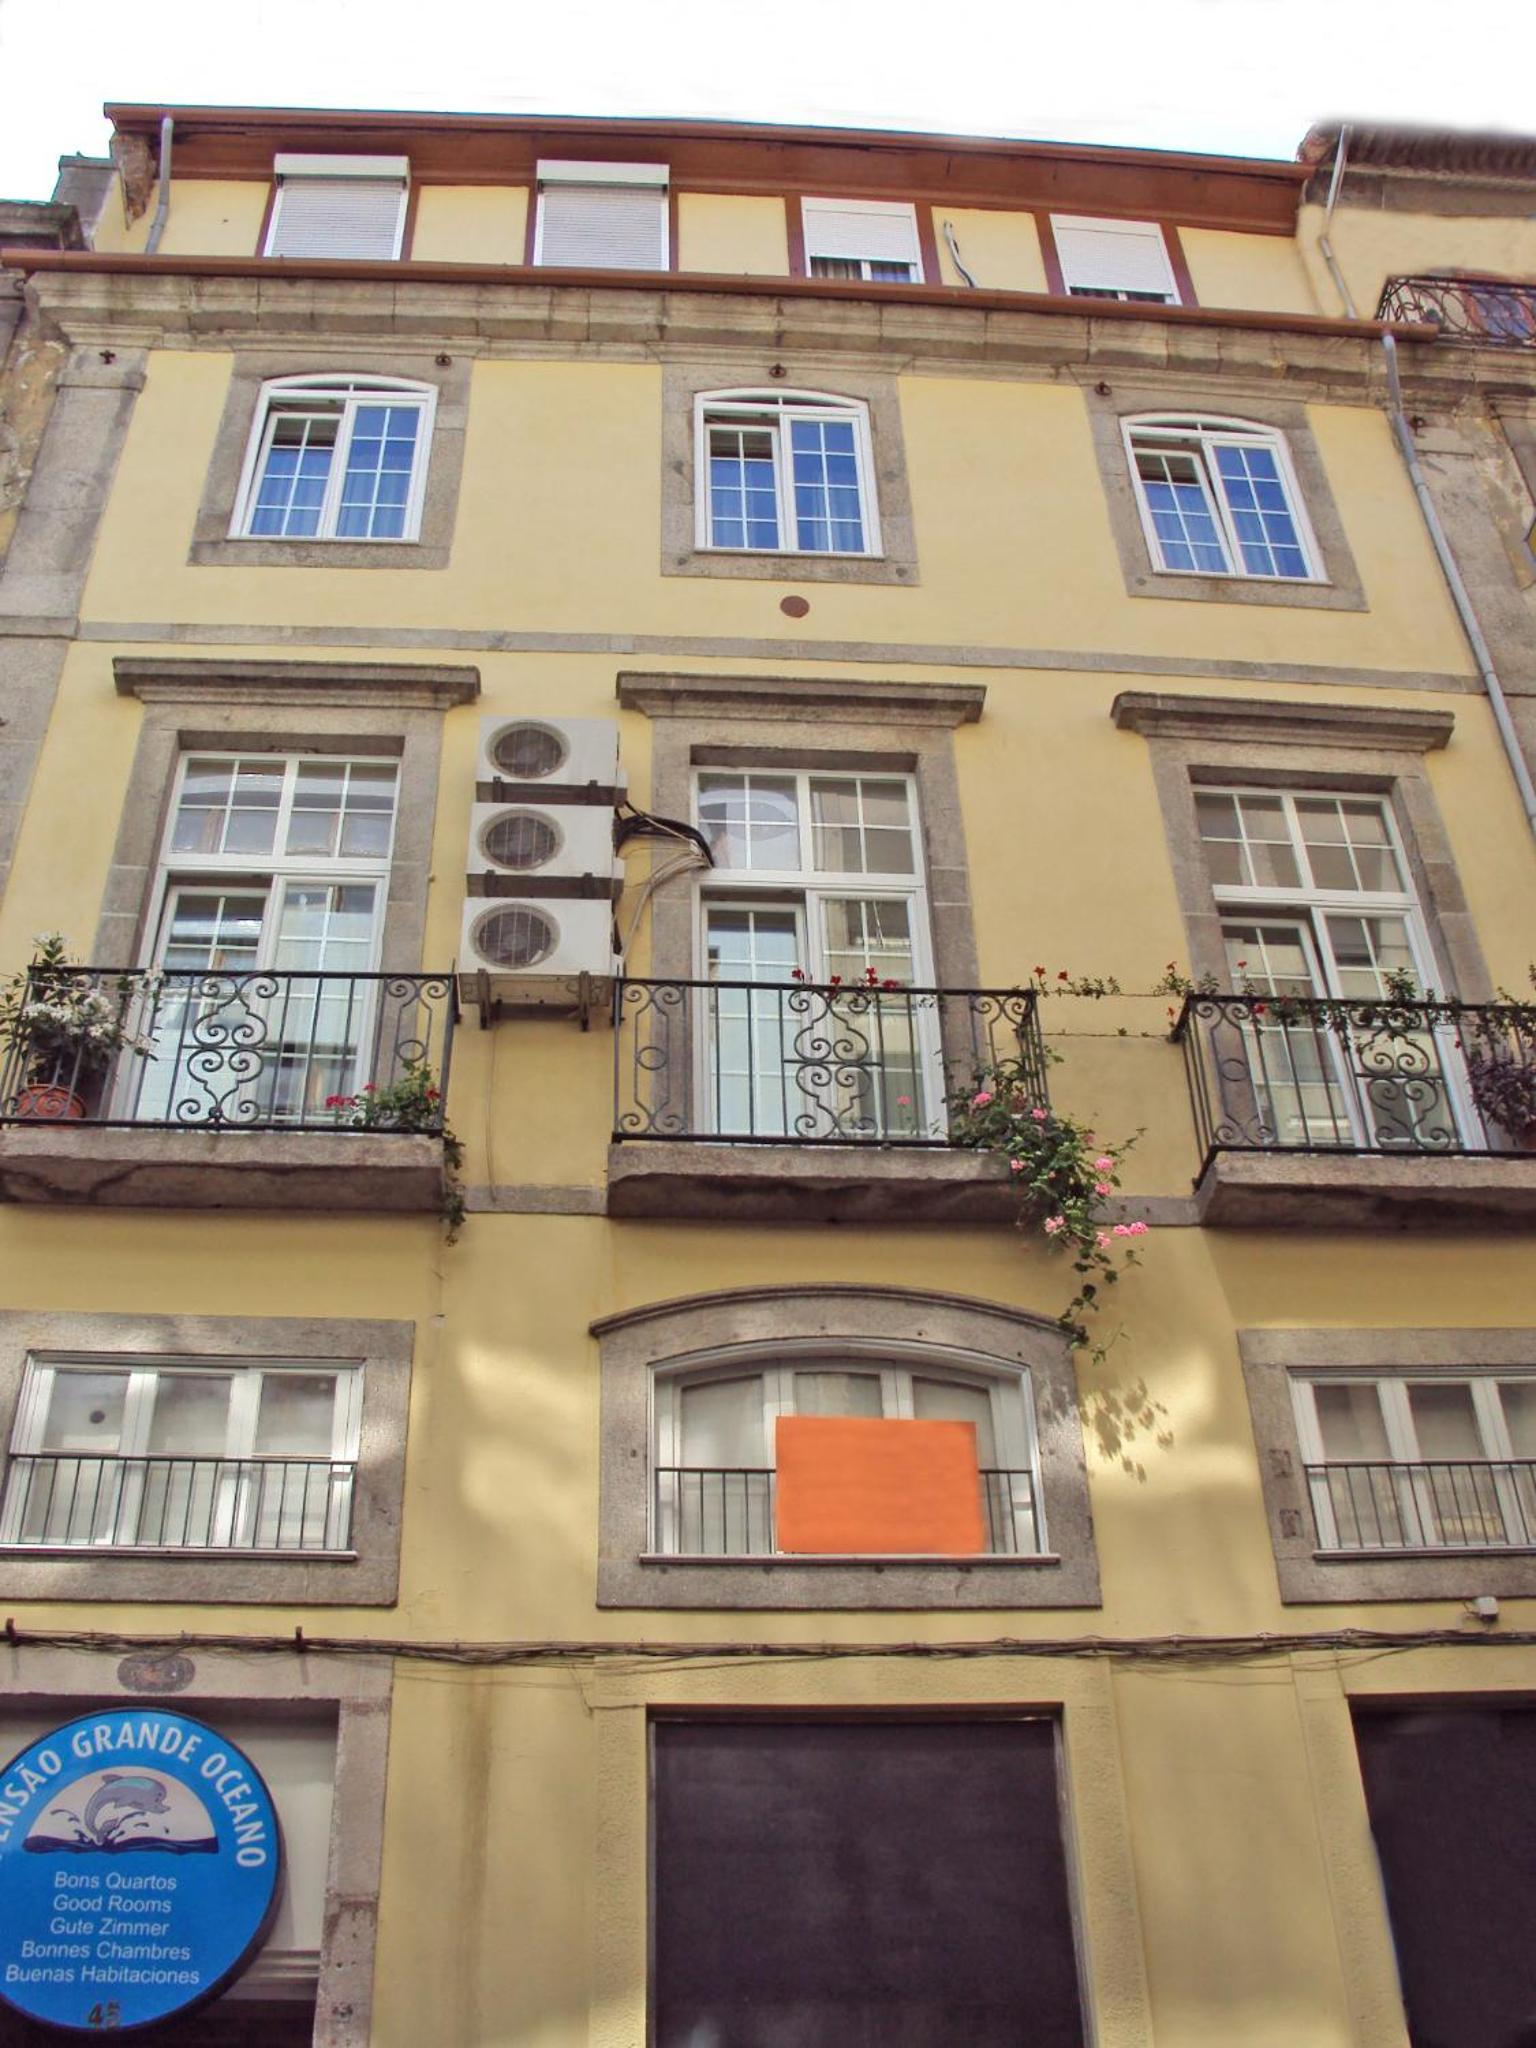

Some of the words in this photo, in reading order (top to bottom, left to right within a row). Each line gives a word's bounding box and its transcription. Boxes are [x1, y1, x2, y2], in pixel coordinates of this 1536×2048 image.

[72, 1722, 203, 1764] GRANDE
[201, 1752, 268, 1868] OCEANO
[54, 1871, 100, 1889] Bons
[105, 1872, 178, 1891] Quartos
[53, 1894, 103, 1911] Good
[108, 1895, 172, 1913] Rooms
[50, 1917, 94, 1934] Gute
[98, 1918, 170, 1936] Zimmer
[21, 1940, 91, 1958] Bonnes
[96, 1941, 191, 1960] Chambres
[5, 1964, 75, 1982] Buenas
[81, 1965, 200, 1985] Habitaciones
